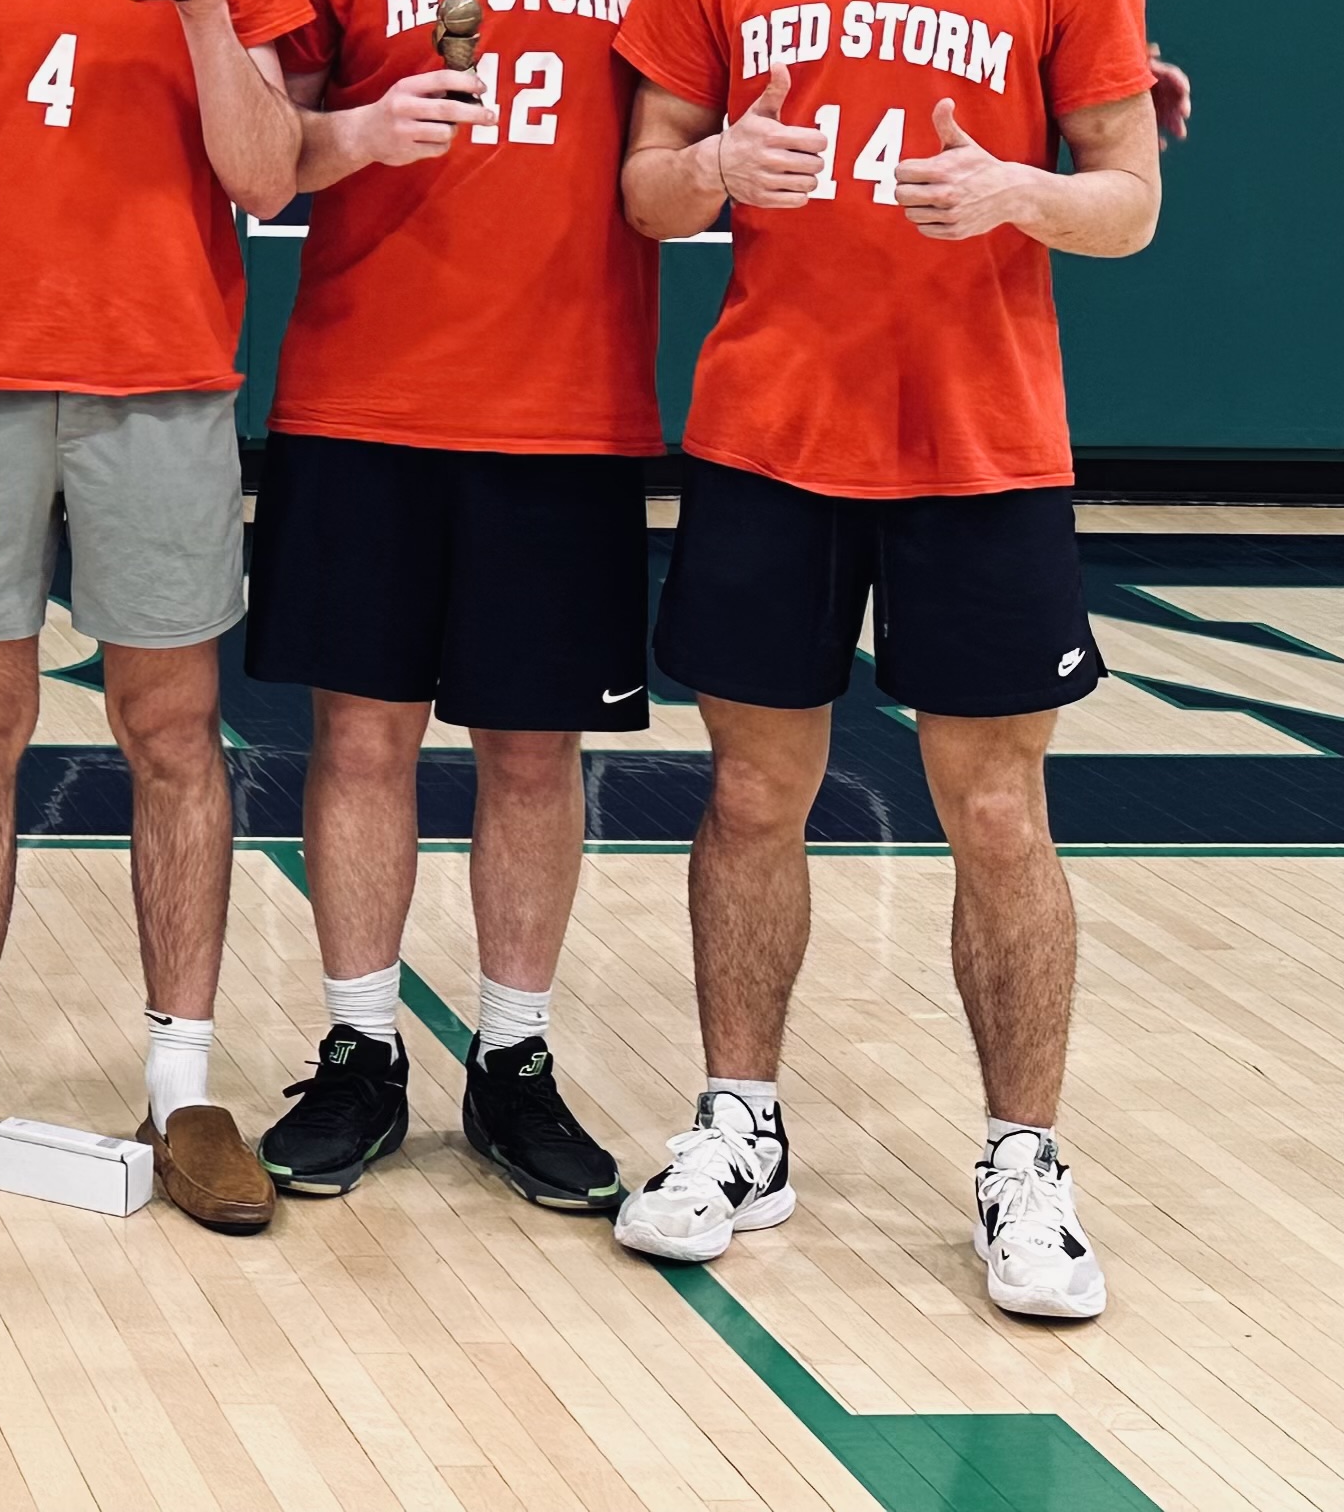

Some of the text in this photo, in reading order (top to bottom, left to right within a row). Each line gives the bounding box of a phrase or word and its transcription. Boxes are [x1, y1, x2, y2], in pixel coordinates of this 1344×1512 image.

[26, 33, 78, 128] 4
[741, 0, 1013, 95] RED STORM
[808, 104, 905, 206] 14
